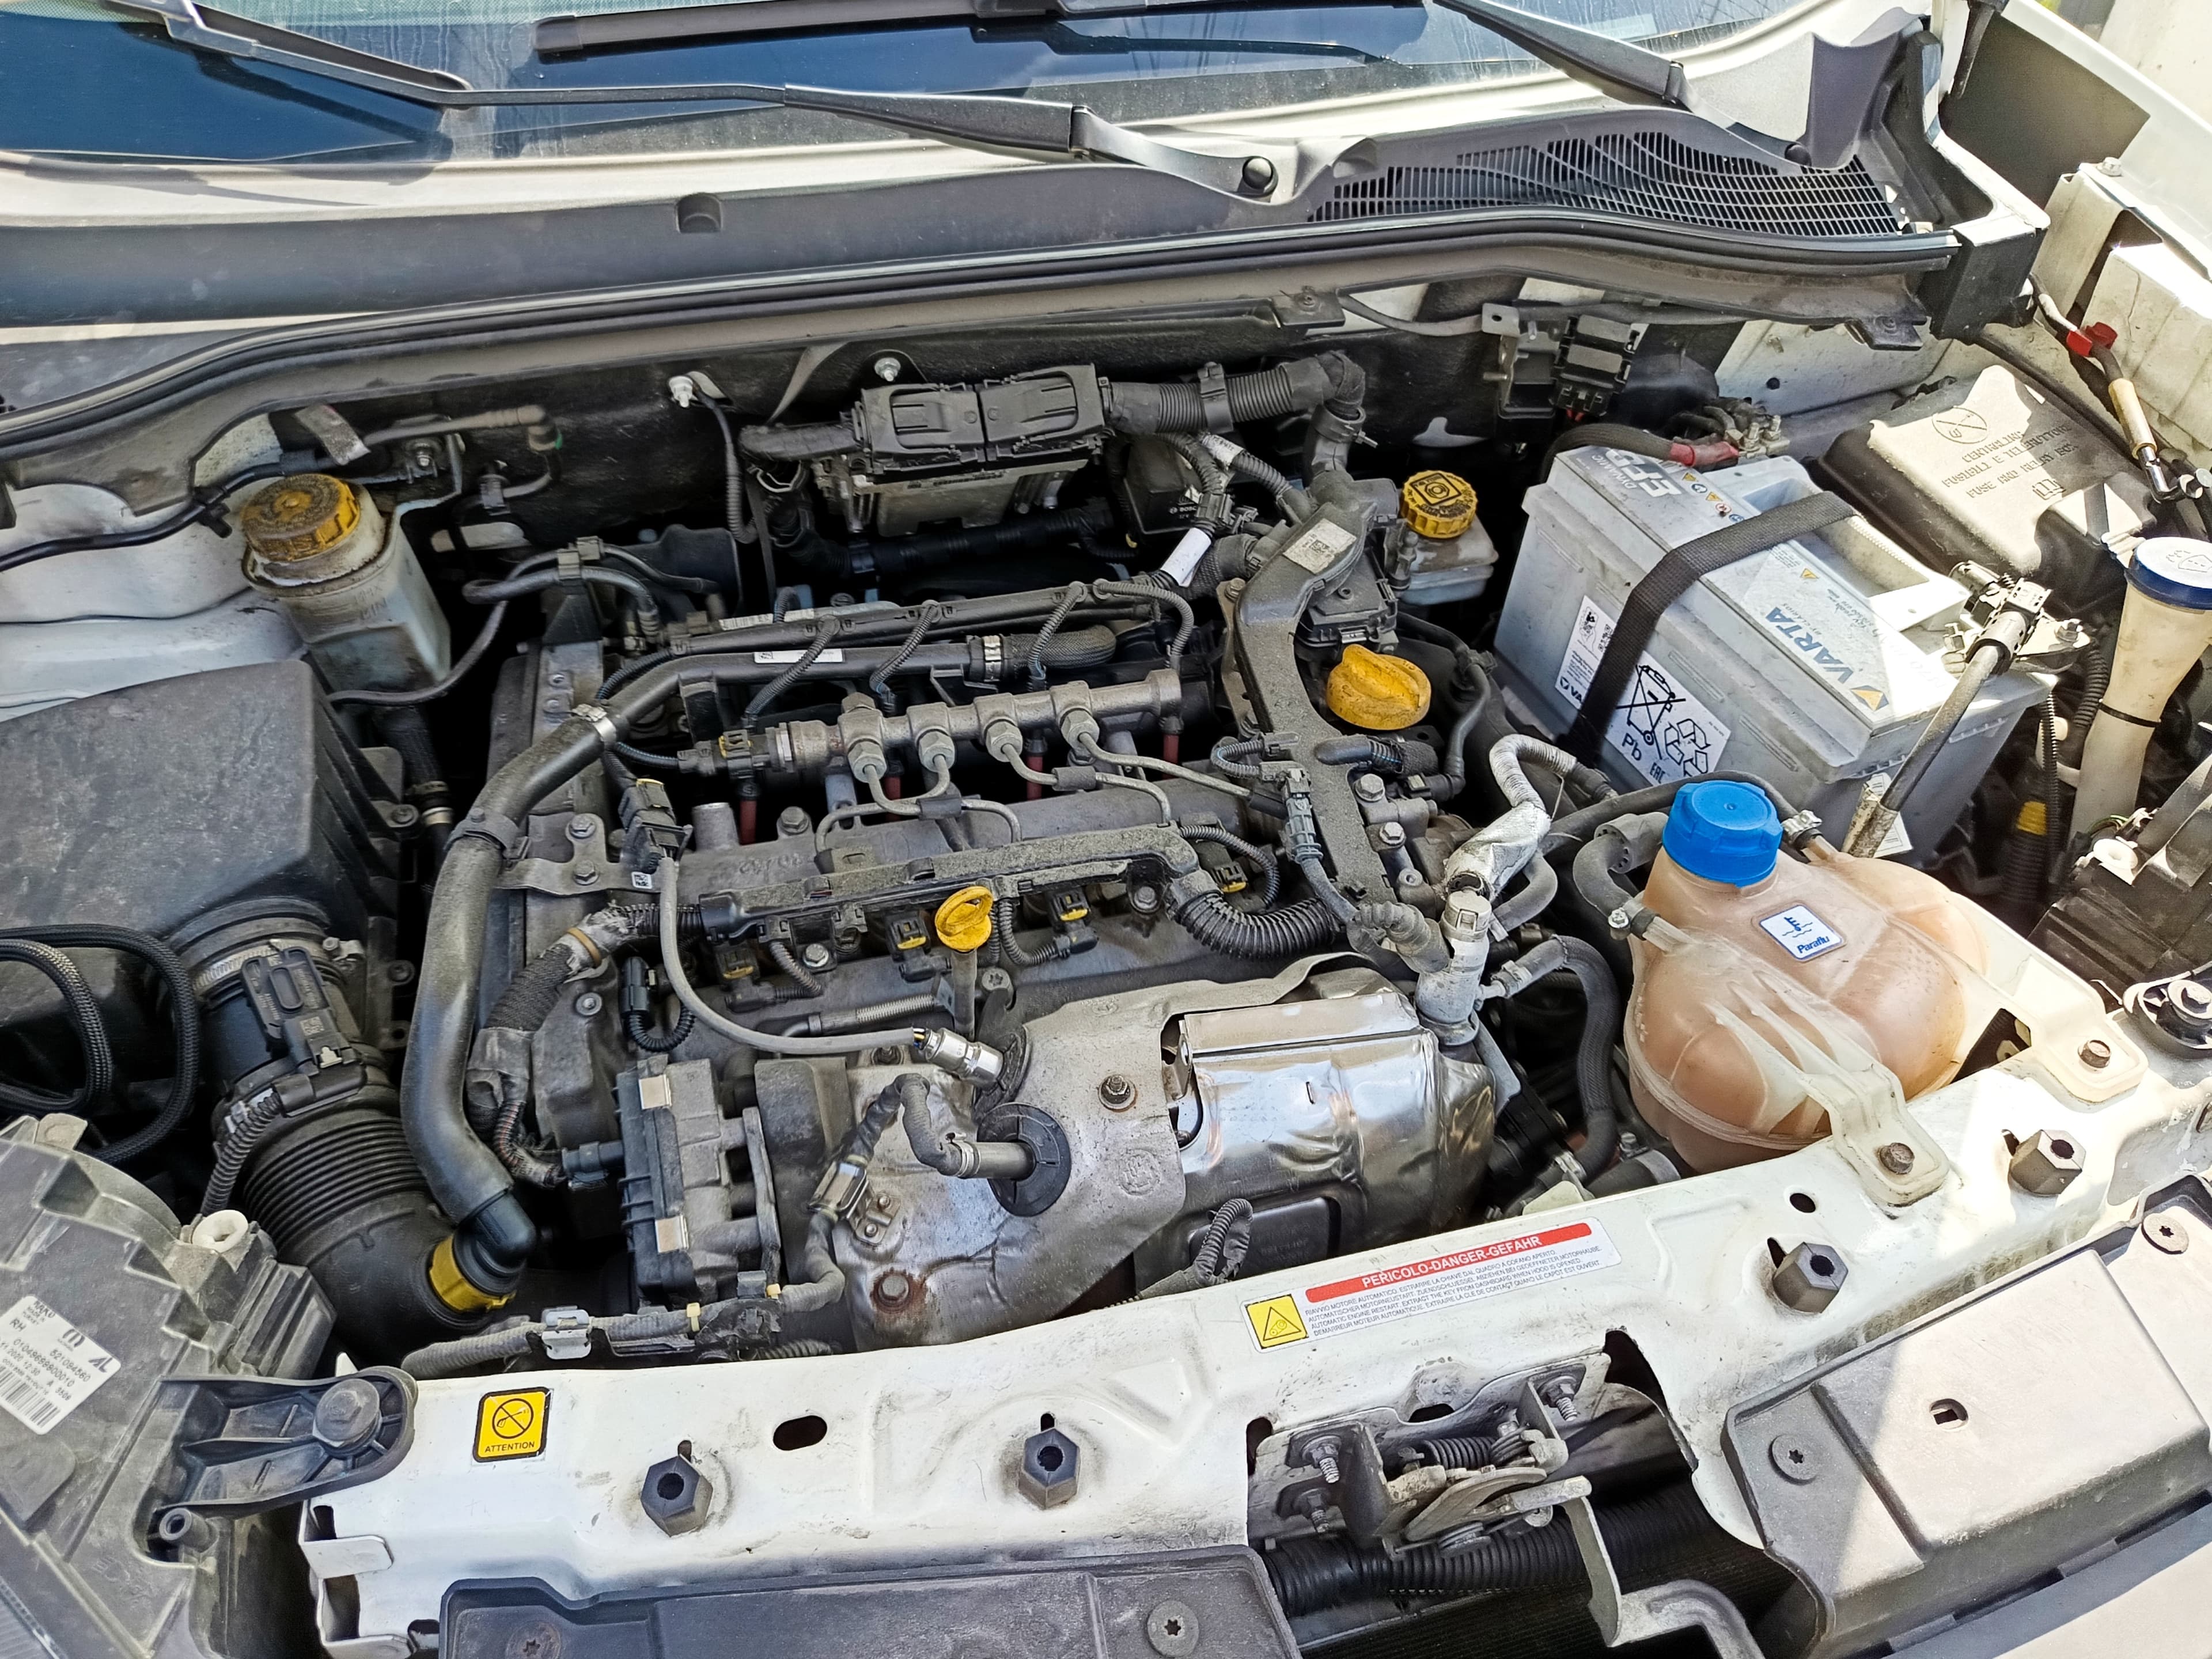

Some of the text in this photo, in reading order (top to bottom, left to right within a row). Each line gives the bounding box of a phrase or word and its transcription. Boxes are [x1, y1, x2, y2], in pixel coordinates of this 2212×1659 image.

[1590, 453, 1639, 489] DYNAMIC
[1607, 448, 1681, 497] EFB
[1992, 453, 2003, 464] E
[1966, 482, 1996, 498] FUSE
[1998, 470, 2020, 485] AND
[2020, 452, 2055, 472] RELAY
[1765, 607, 1854, 684] VARTA
[1622, 734, 1643, 762] Pb
[1797, 936, 1830, 953] Paraflu
[1362, 1234, 1541, 1288] PERICOLO-DANGER-GEFAHR
[9, 1319, 26, 1331] RH
[484, 1441, 535, 1453] ATTENTION
